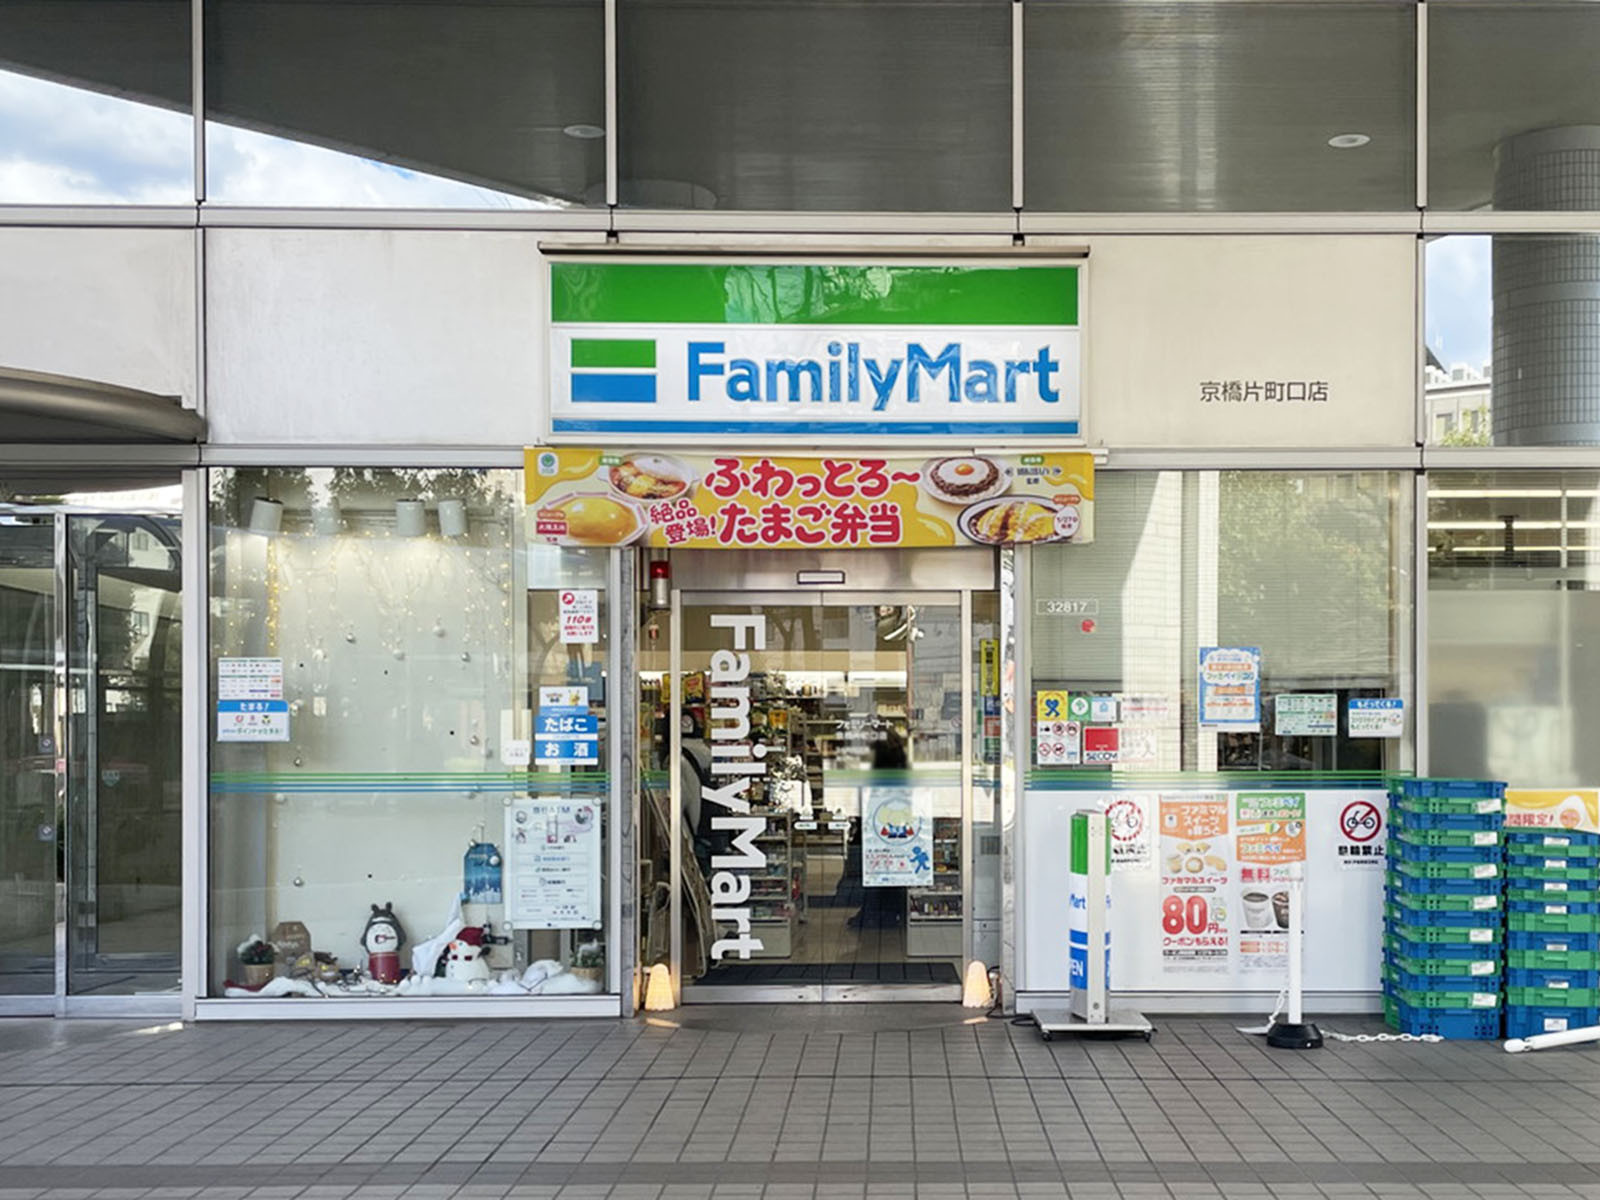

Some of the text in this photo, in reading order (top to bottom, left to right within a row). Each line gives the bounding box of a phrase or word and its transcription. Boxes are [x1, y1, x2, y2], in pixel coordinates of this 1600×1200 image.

[687, 341, 1061, 412] FamilyMart
[1199, 380, 1330, 403] 京橋片町口店
[650, 499, 698, 525] 絶品
[719, 503, 901, 545] たまご弁当
[665, 516, 717, 546] 登場!
[1047, 601, 1088, 613] 32817
[544, 717, 588, 732] たばこ
[544, 741, 589, 757] お酒
[702, 614, 767, 961] FamilyMart
